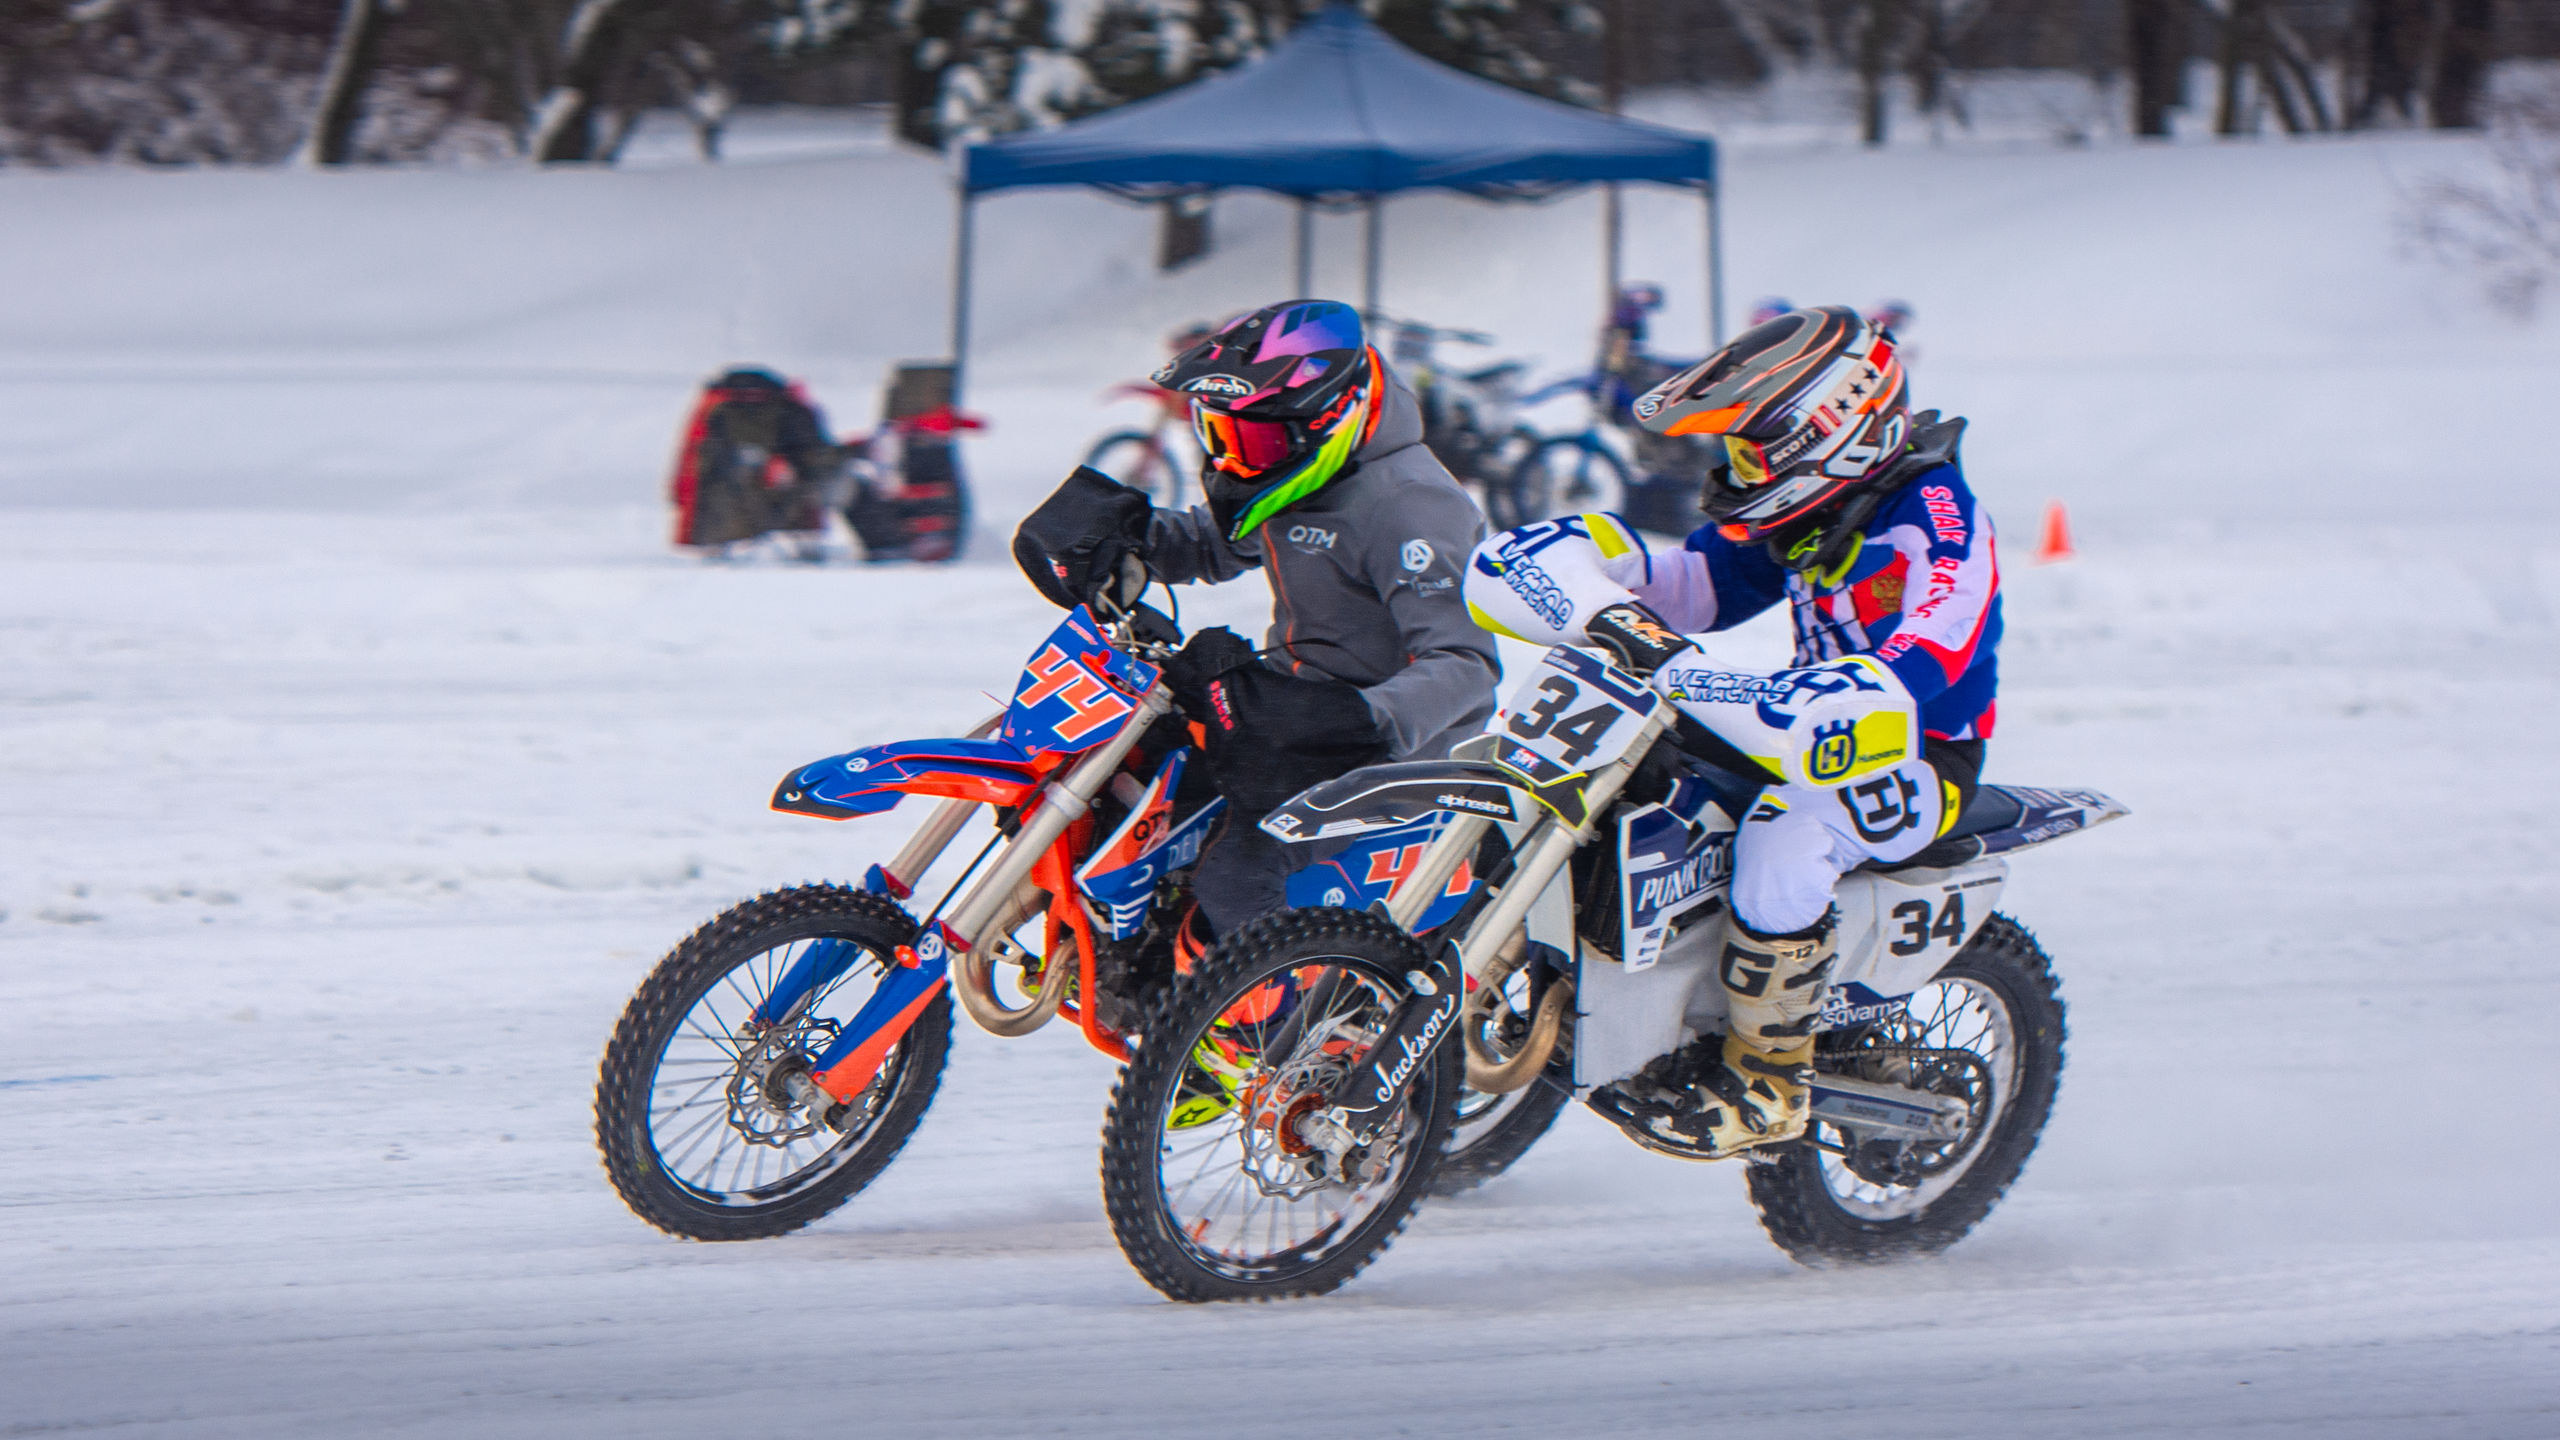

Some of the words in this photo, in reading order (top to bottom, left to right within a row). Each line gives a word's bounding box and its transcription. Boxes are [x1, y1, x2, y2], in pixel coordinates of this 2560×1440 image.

[1188, 378, 1248, 395] Airoh
[1770, 426, 1817, 465] SCOTT
[1920, 485, 1968, 546] SHAK
[1287, 525, 1338, 549] QTM
[1023, 642, 1135, 743] 44
[1669, 669, 1795, 693] VECTOR
[1693, 687, 1785, 705] RACING
[1507, 675, 1624, 767] 34
[1437, 794, 1510, 815] alpinestars
[1889, 891, 1965, 957] 34
[1373, 994, 1455, 1103] Jackson
